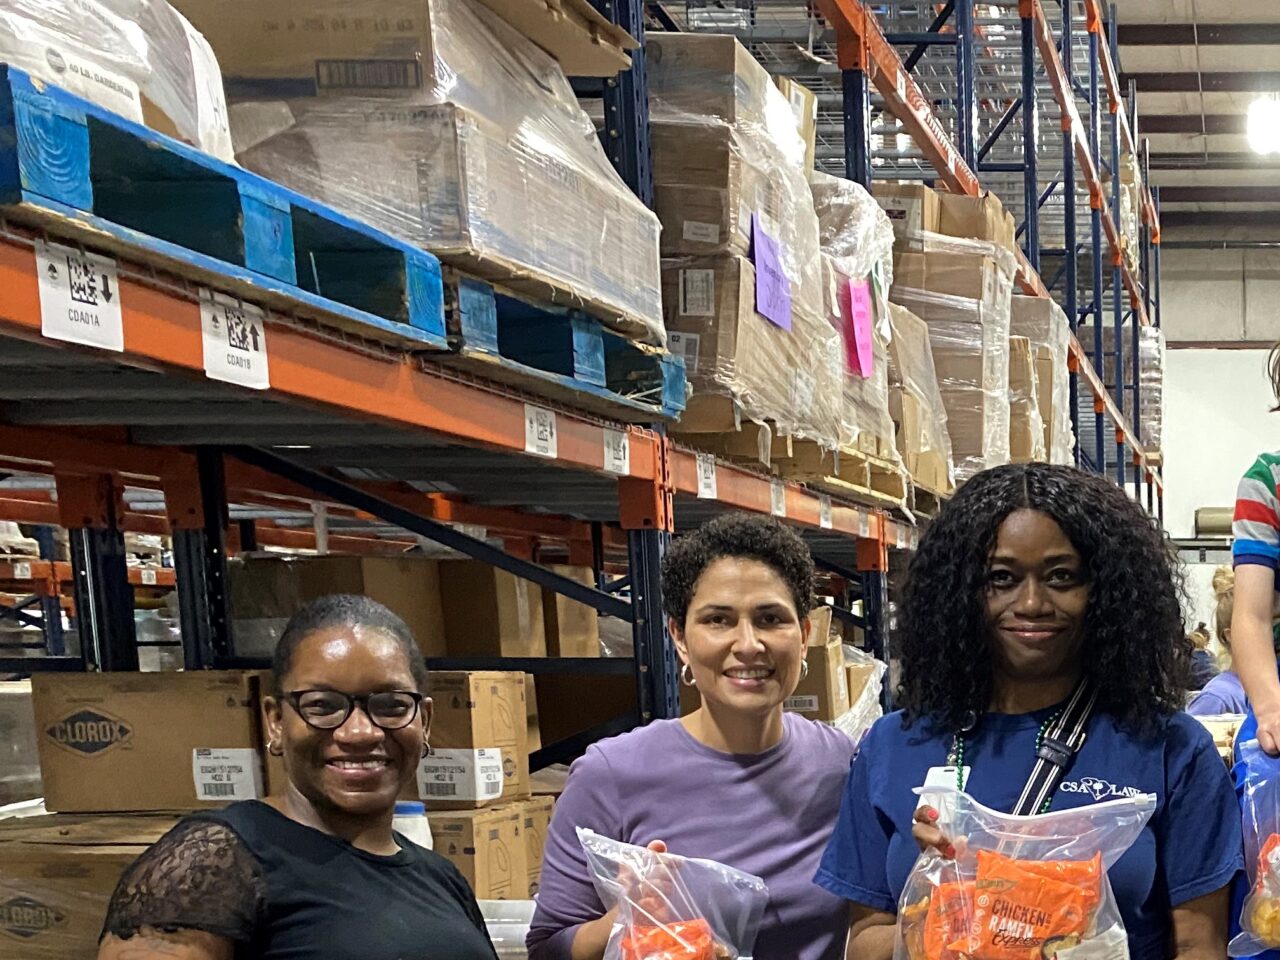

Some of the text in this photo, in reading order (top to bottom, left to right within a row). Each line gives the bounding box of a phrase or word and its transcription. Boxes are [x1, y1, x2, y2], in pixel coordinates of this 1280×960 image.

[68, 309, 100, 327] CDA01A
[54, 720, 121, 743] CLOROX
[1060, 781, 1089, 794] CSA
[992, 899, 1047, 927] CHICKEN
[988, 914, 1034, 940] RAMEN
